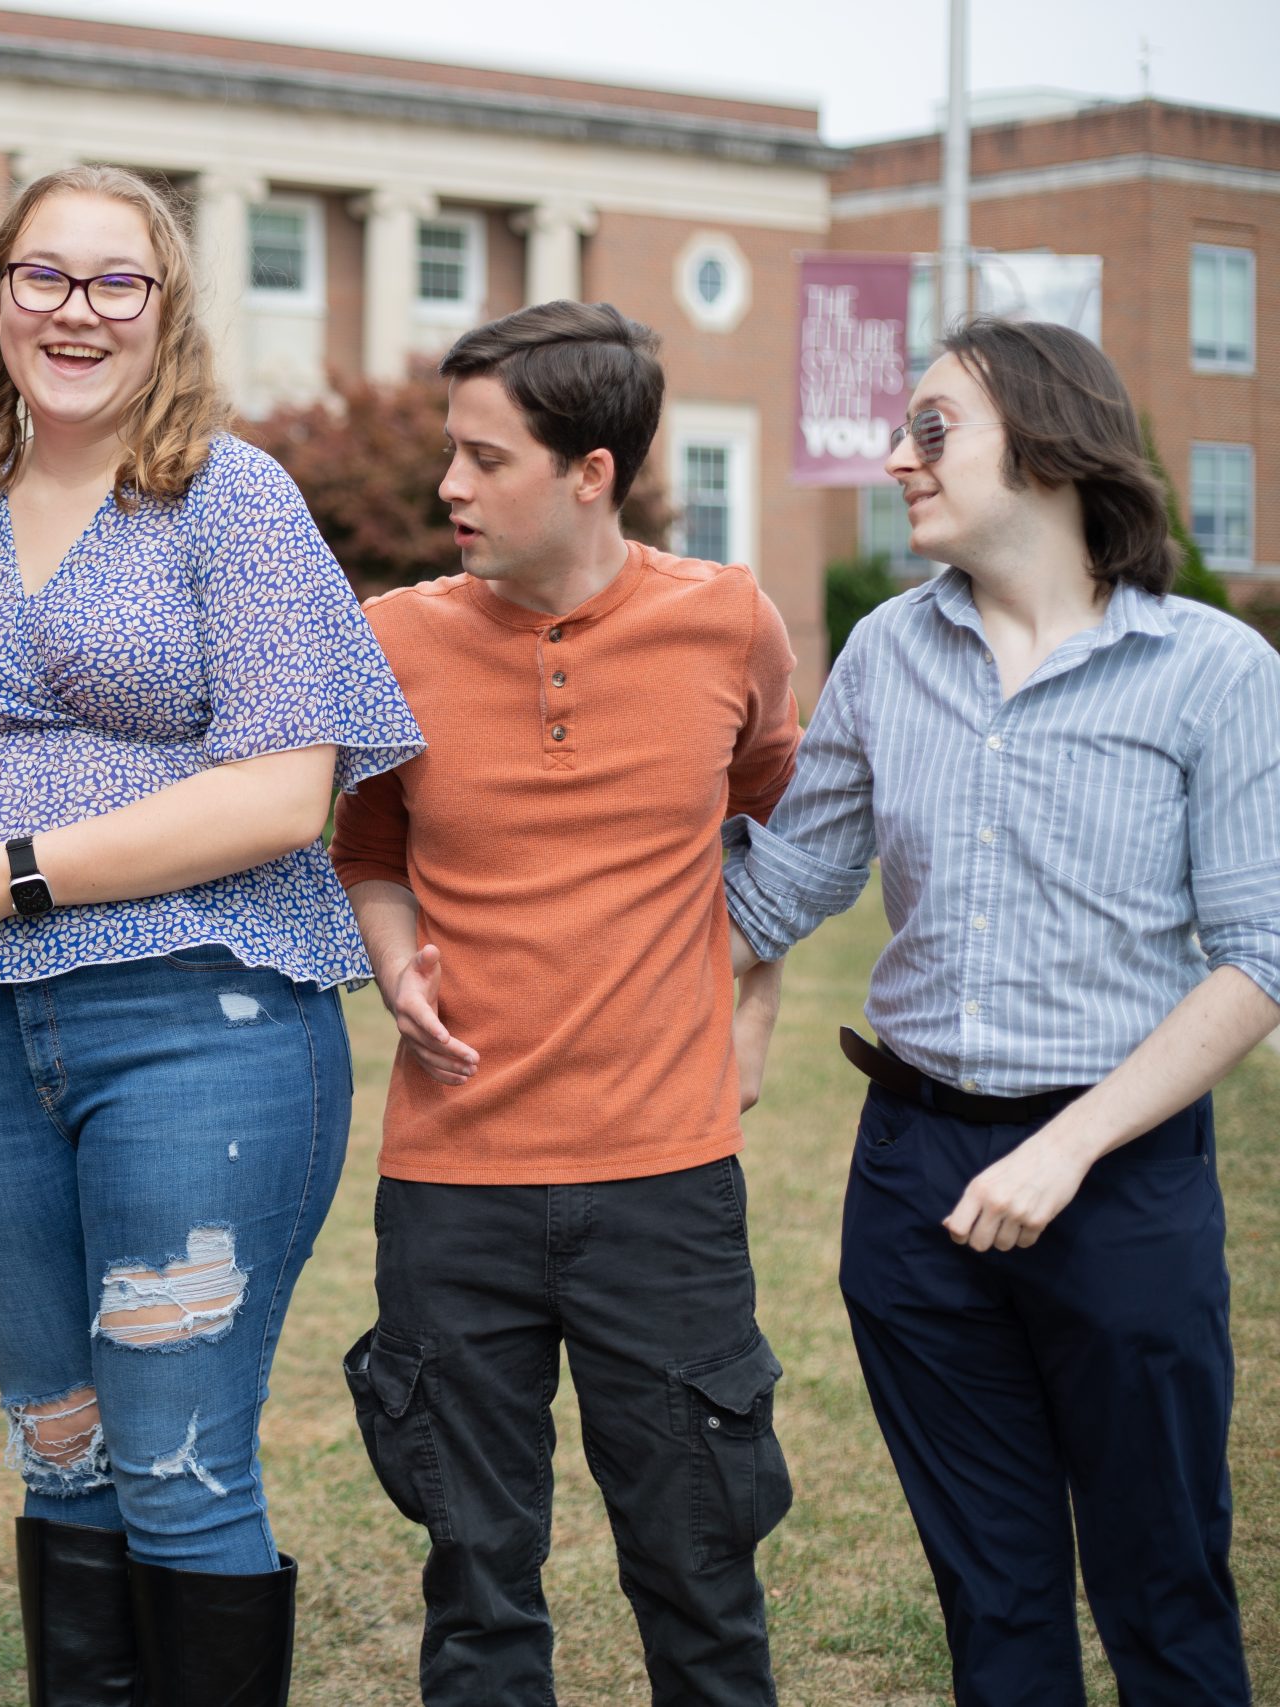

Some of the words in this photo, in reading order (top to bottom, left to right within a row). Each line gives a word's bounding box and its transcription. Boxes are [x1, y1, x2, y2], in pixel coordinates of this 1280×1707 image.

[806, 284, 858, 321] THE
[802, 318, 903, 356] FUTURE
[801, 351, 904, 393] STARTS
[800, 417, 890, 458] YOU
